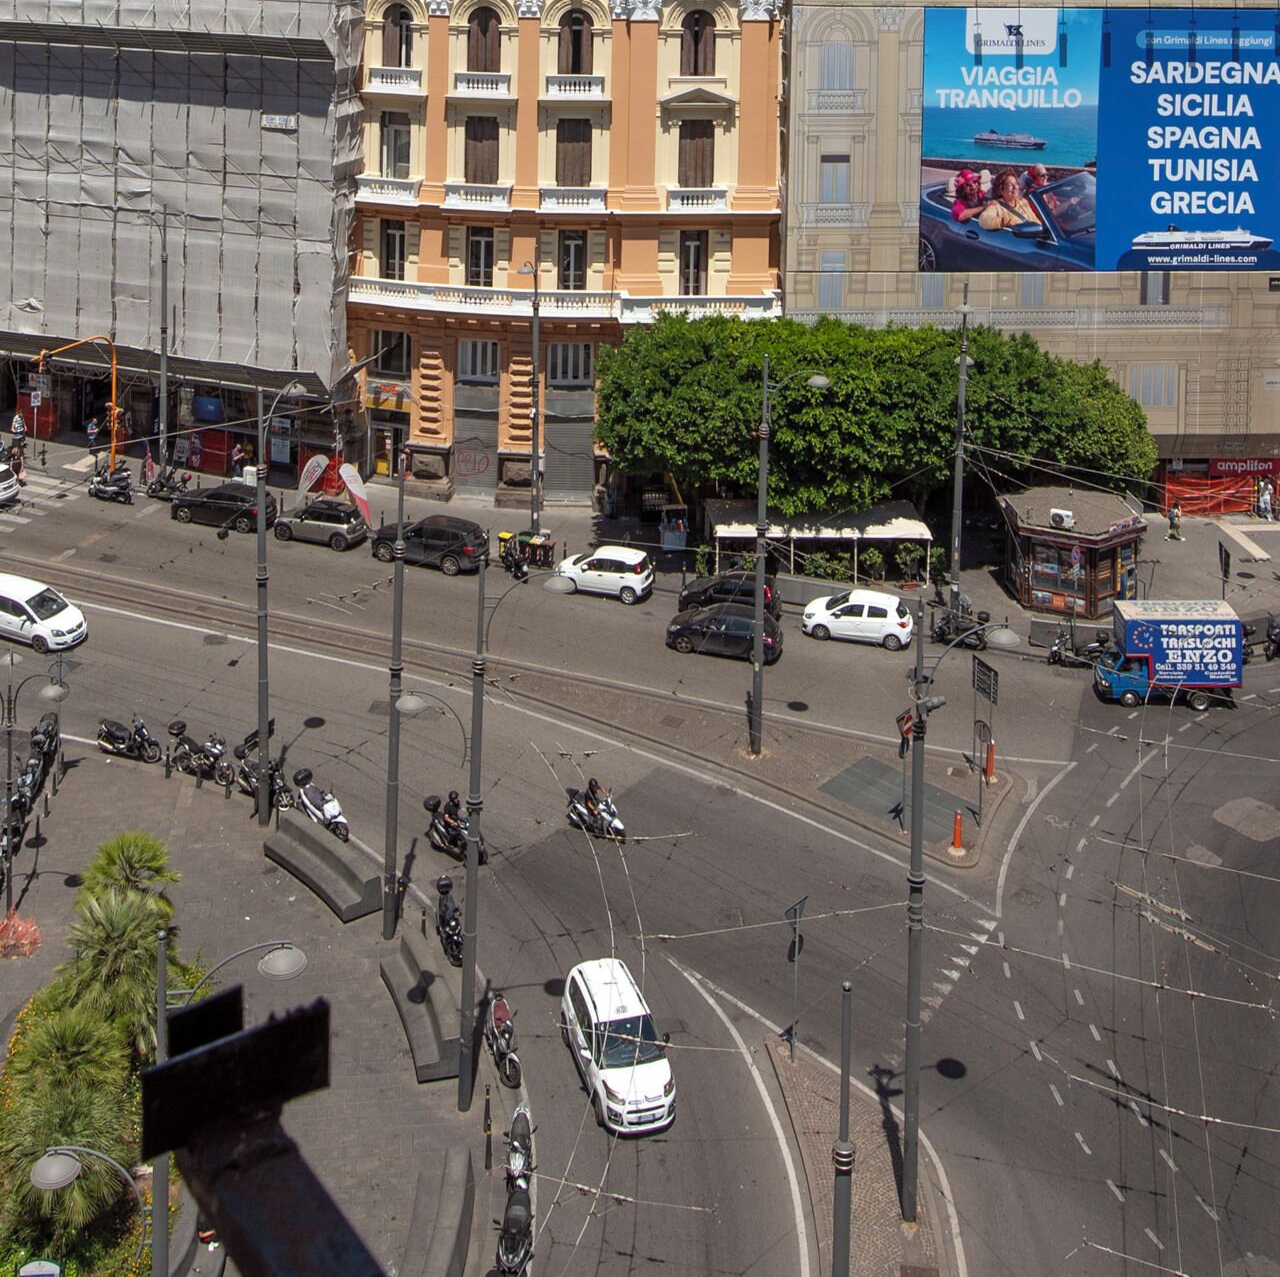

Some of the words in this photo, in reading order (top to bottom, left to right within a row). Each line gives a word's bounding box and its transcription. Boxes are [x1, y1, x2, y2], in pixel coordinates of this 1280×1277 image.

[976, 39, 1021, 47] GRIMALDI
[1022, 39, 1046, 47] LINES
[1145, 37, 1163, 45] con
[1163, 35, 1204, 45] Grimaldi
[1204, 35, 1229, 45] Lines
[1230, 36, 1273, 47] raggiungi
[960, 66, 1059, 86] VIAGGIA
[935, 88, 1082, 111] TRANQUILLO
[1157, 93, 1254, 117] SICILIA
[1147, 126, 1262, 150] SPAGNA
[1148, 158, 1259, 182] TUNISIA
[1150, 190, 1256, 215] GRECIA
[1147, 254, 1258, 264] www.grimaldi-lines.com
[1216, 459, 1273, 473] amplifon
[1160, 624, 1236, 636] TRASPORTI
[1160, 637, 1237, 649] TRASLOCHI
[1165, 649, 1233, 663] ENZO
[1155, 663, 1174, 671] Cell.
